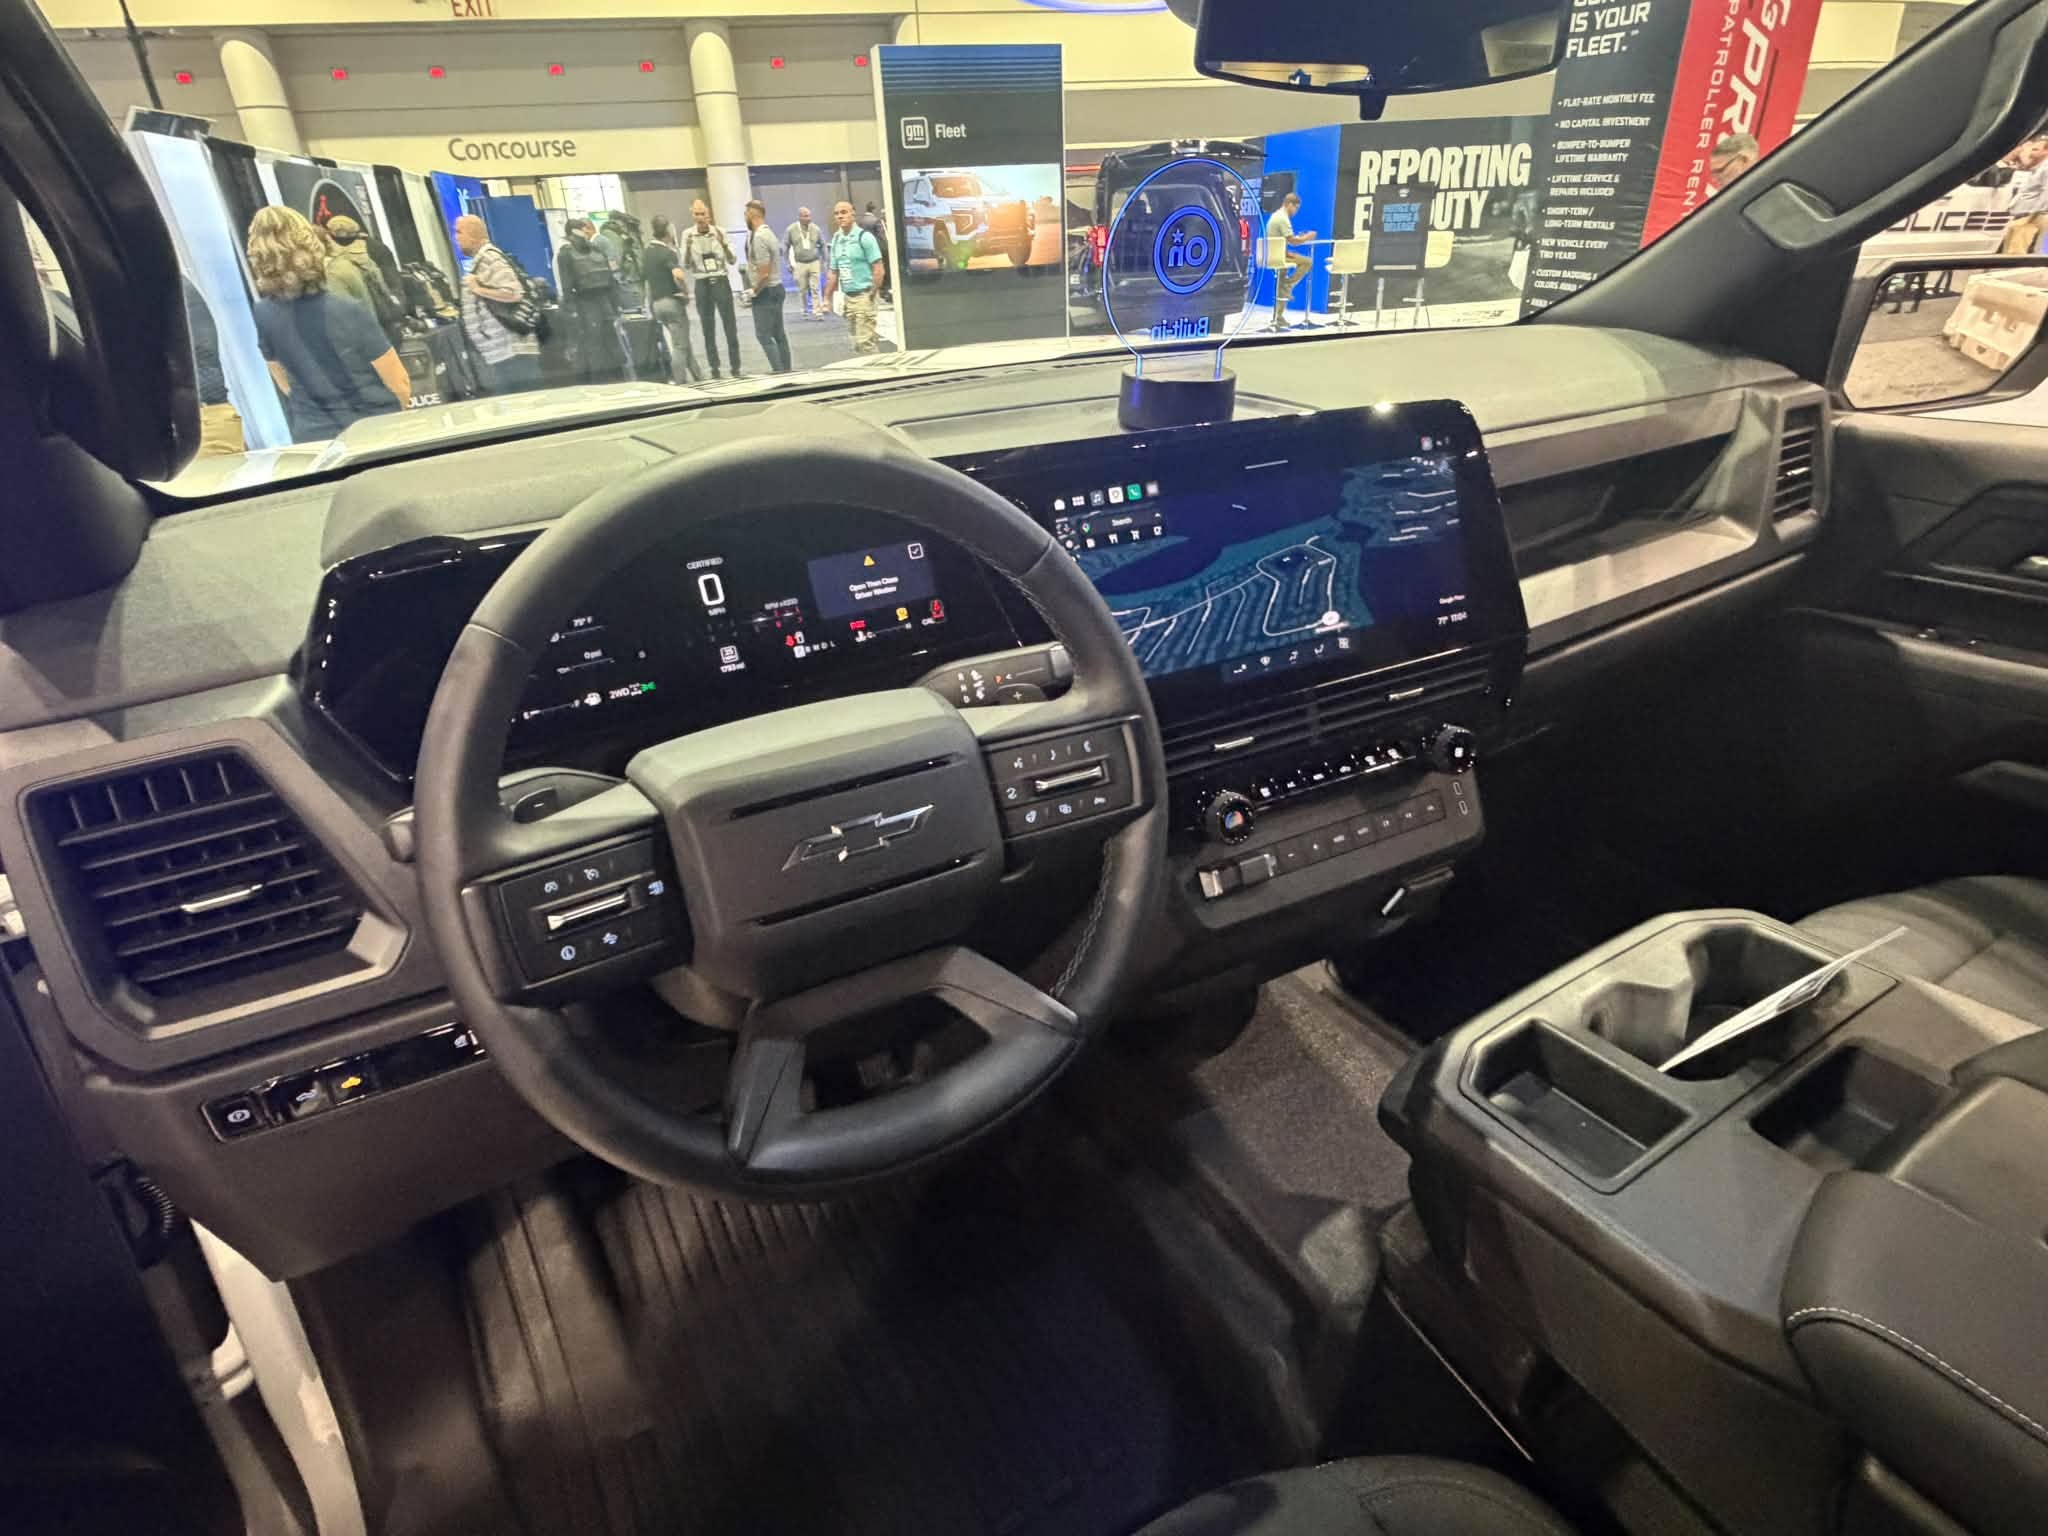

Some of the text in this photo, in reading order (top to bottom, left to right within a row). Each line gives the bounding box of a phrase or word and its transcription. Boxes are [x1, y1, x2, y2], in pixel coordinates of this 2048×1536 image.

[452, 0, 492, 17] EXIT
[1569, 2, 1652, 33] IS YOUR
[1563, 96, 1602, 108] FLAT-RATE
[1602, 93, 1639, 105] MONTHLY
[905, 123, 967, 141] gm Fleet
[448, 138, 577, 161] Concourse
[1430, 190, 1490, 231] UTY
[697, 573, 725, 606] 0
